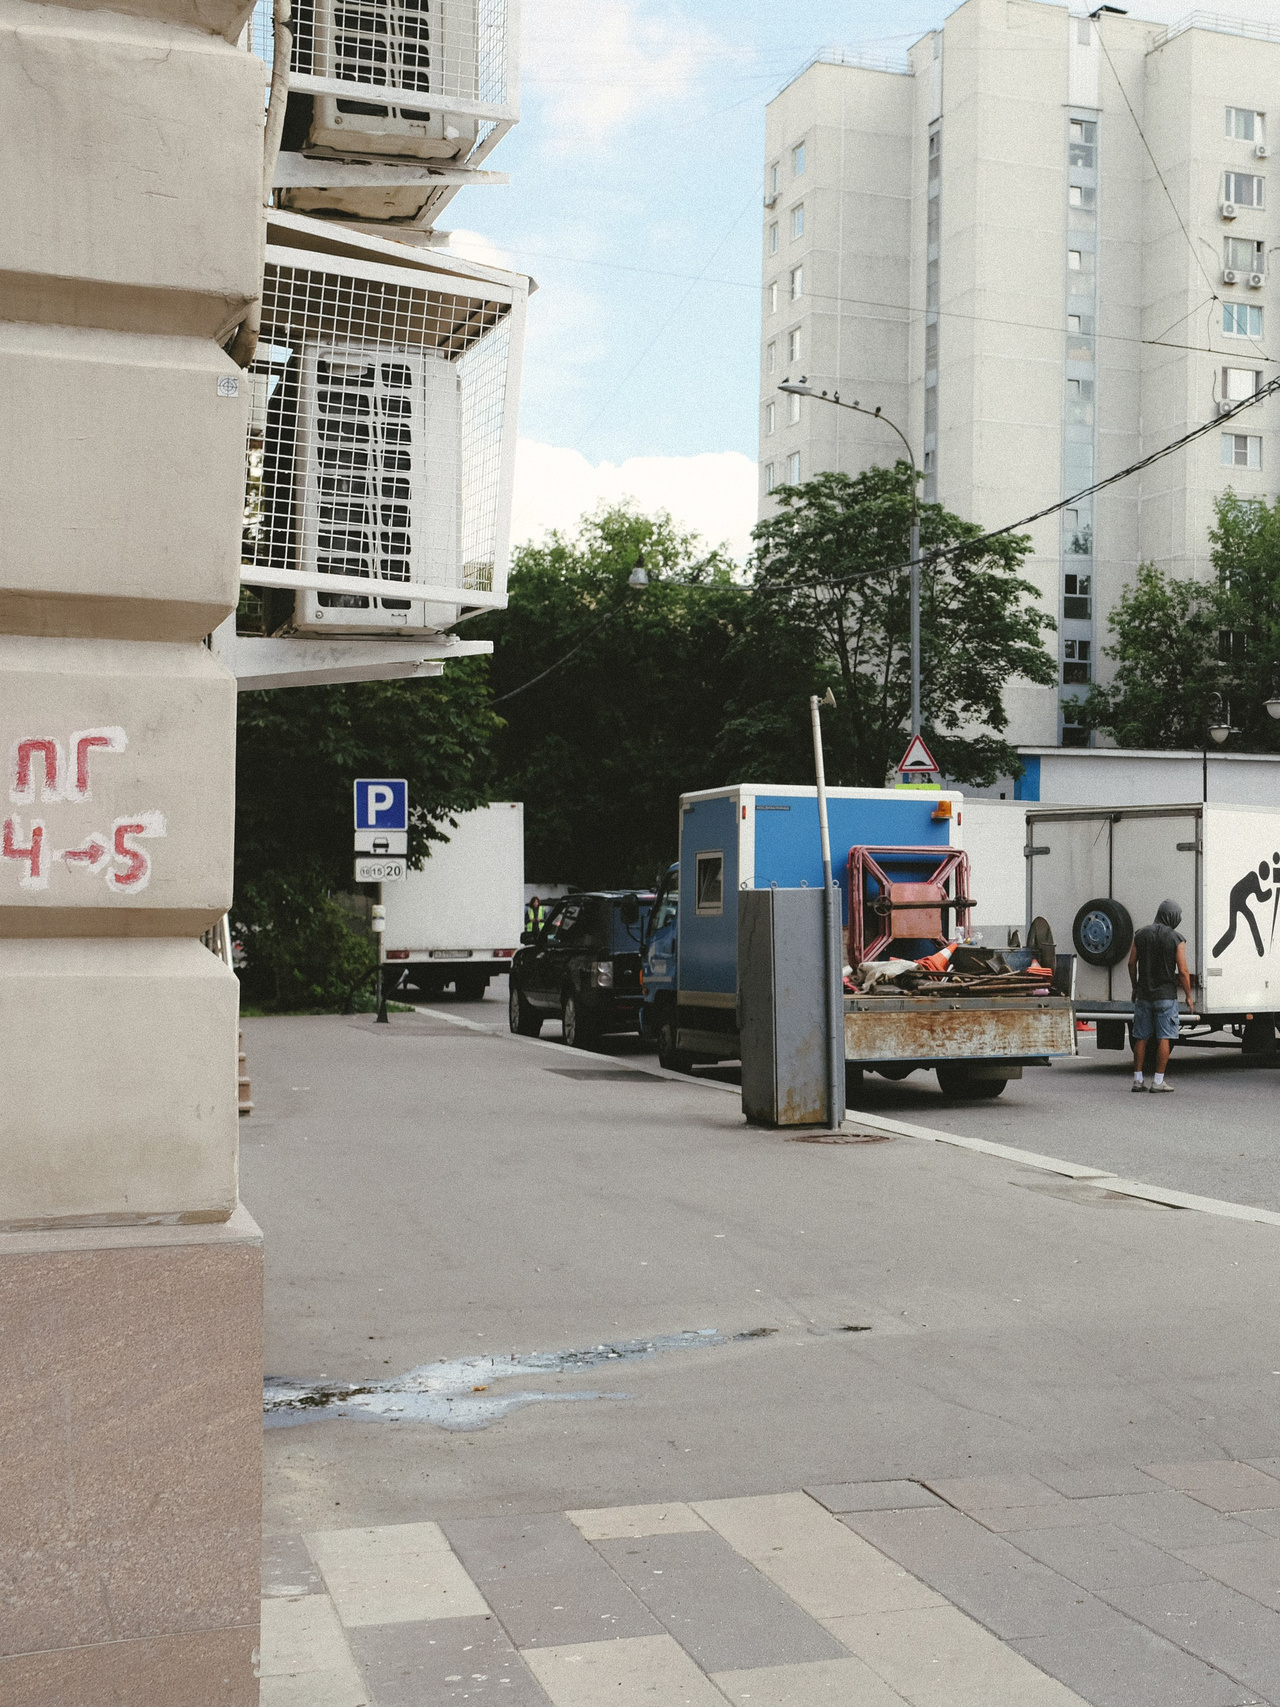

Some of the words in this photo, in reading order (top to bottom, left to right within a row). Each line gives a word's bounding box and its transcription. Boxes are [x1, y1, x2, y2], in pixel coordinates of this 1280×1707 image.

[367, 784, 394, 826] P
[373, 867, 383, 876] 15
[386, 865, 401, 877] 20
